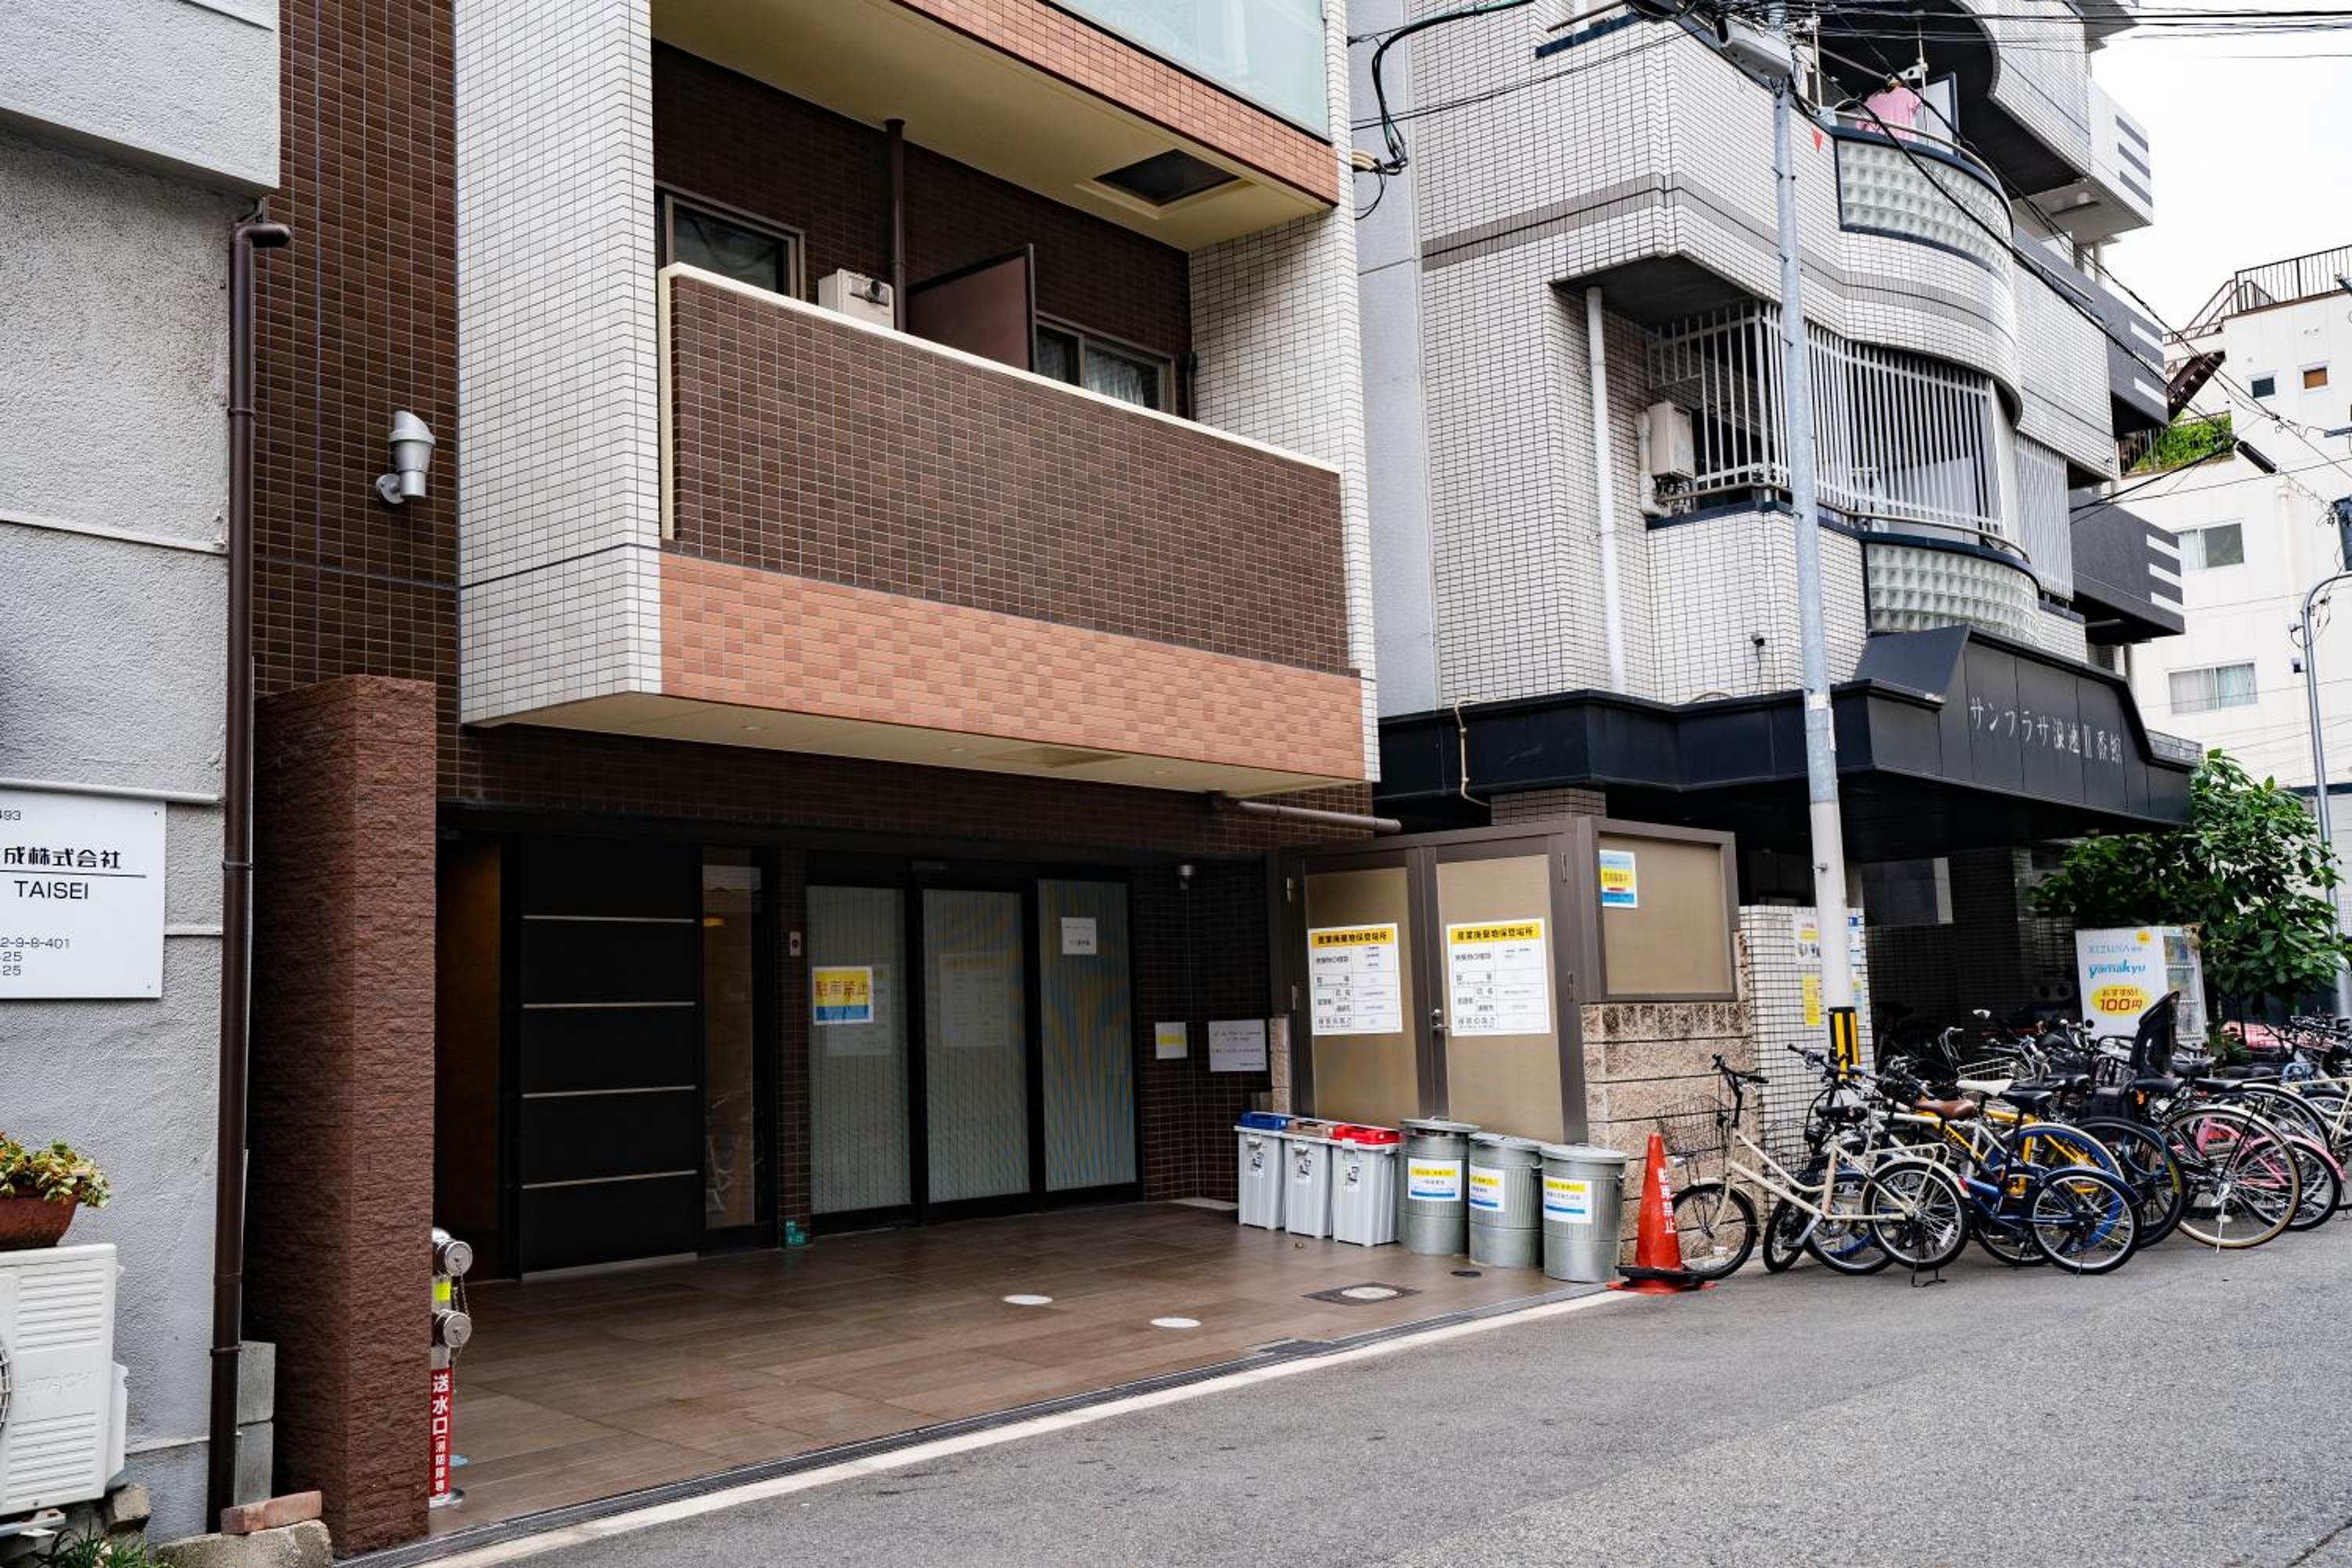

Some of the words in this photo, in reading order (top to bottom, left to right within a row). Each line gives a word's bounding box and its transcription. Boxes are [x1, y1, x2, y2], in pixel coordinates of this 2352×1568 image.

[0, 810, 21, 821] 93
[4, 846, 121, 869] 成株式会社
[13, 880, 89, 900] TAISEI
[2089, 960, 2145, 978] yamakyu
